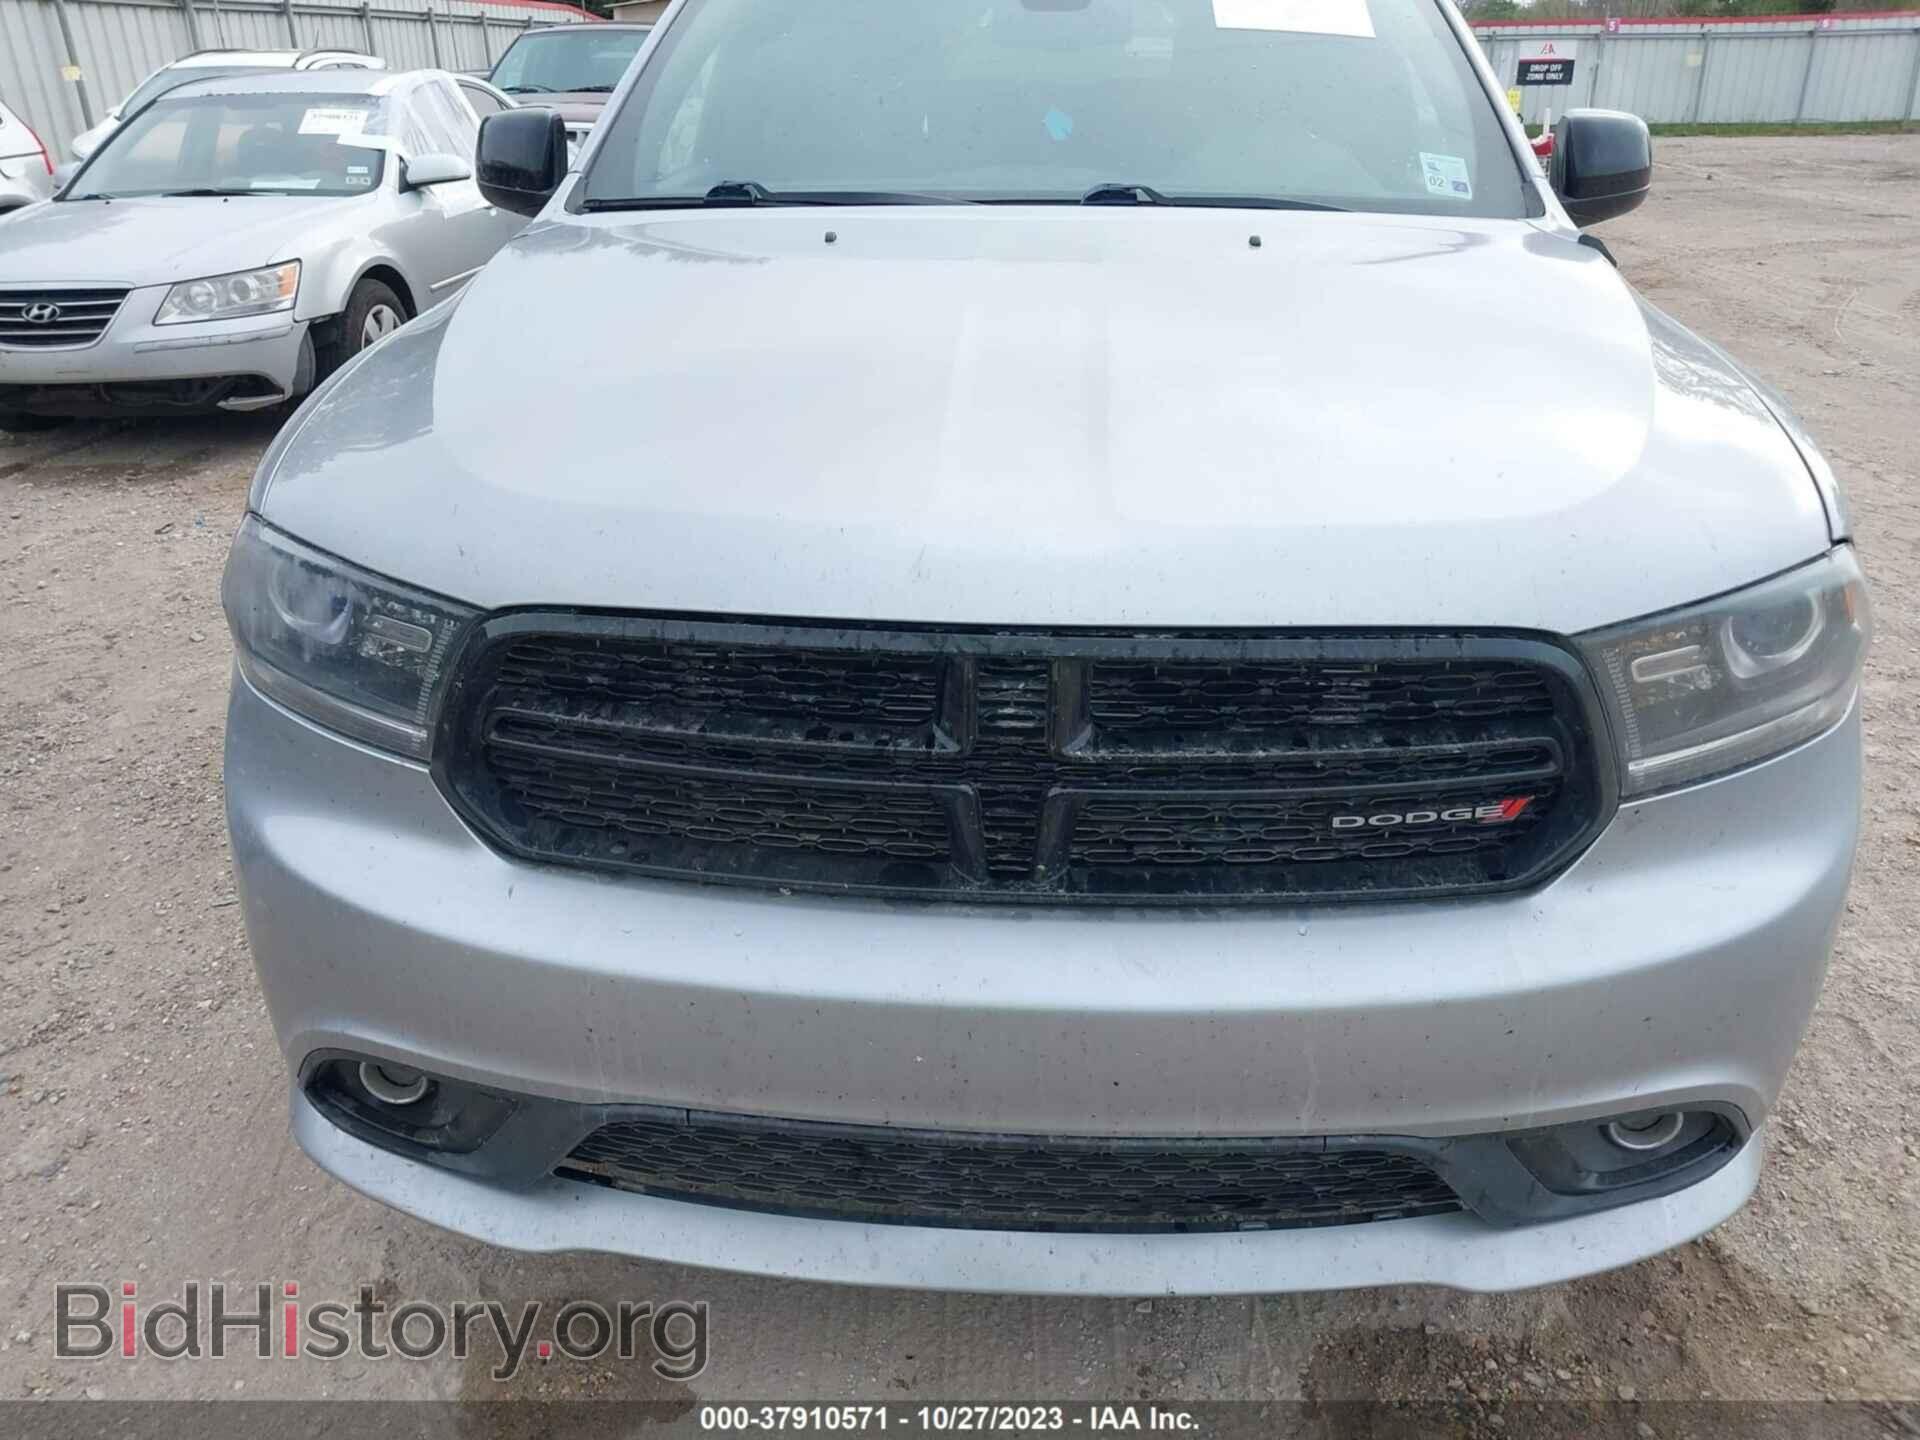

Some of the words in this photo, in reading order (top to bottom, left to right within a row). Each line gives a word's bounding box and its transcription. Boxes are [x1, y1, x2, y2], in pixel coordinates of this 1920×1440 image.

[1530, 64, 1549, 72] DROP
[1550, 64, 1562, 73] OFF
[1526, 72, 1544, 81] ZONE
[1545, 72, 1564, 81] ONLY
[1428, 175, 1445, 188] 02
[1331, 804, 1505, 829] DODGE
